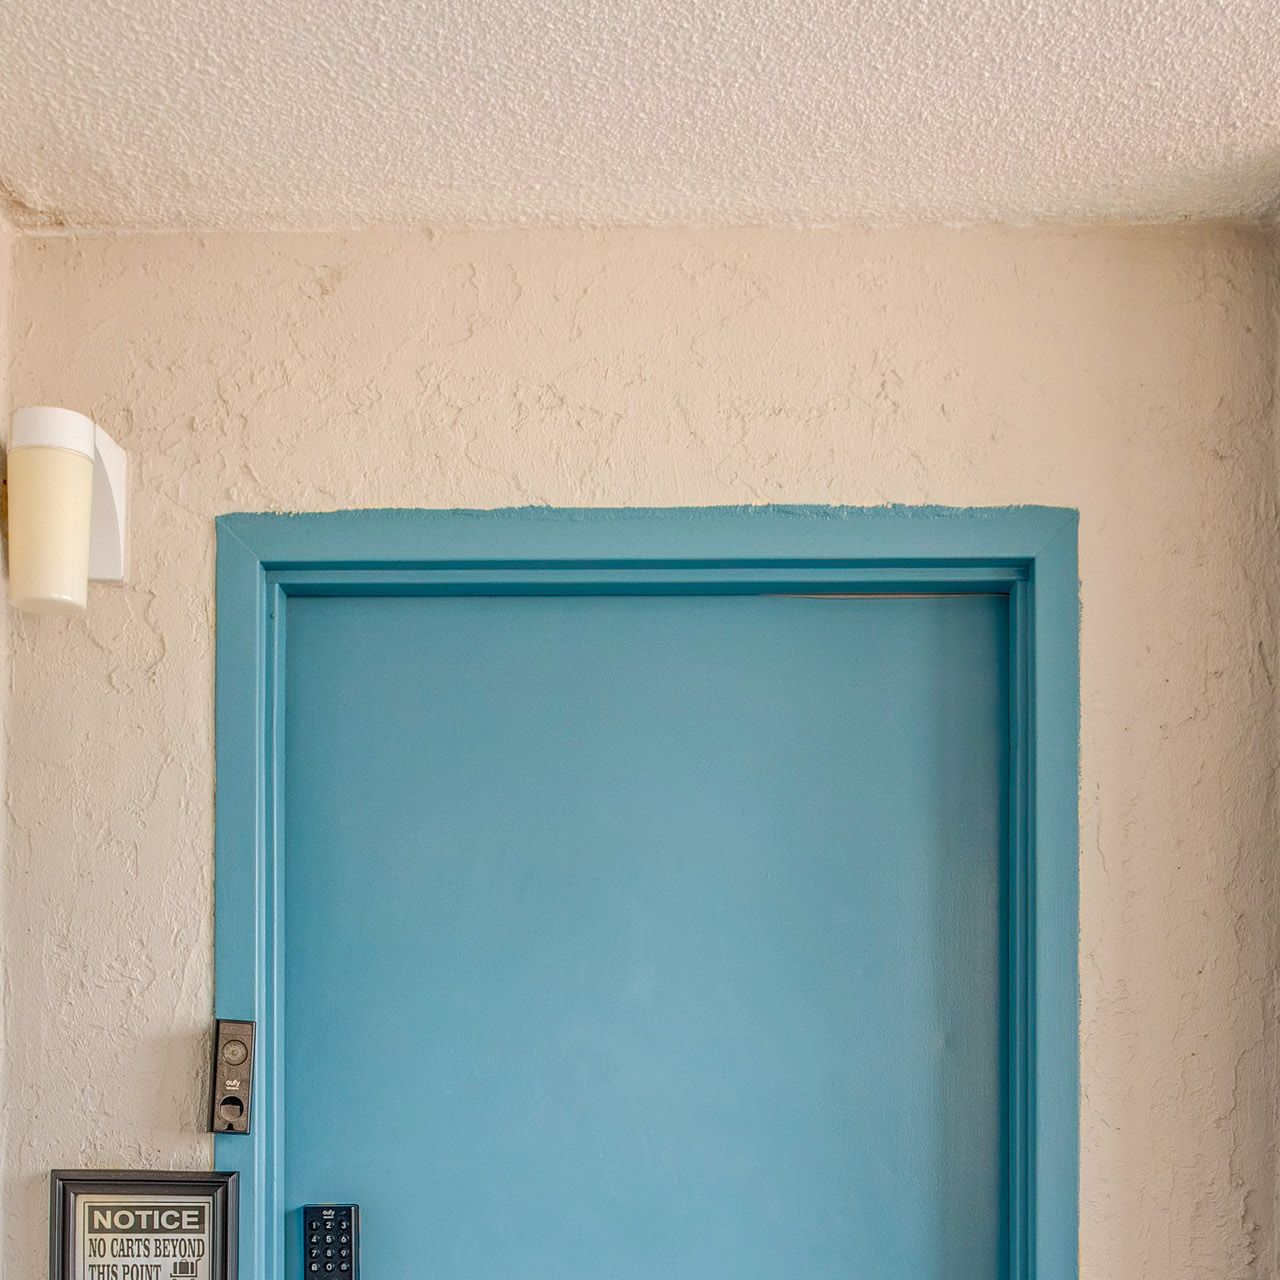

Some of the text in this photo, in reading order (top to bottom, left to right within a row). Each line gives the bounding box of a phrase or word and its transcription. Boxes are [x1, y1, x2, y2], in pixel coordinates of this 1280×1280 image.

[93, 1210, 200, 1230] NOTICE
[88, 1238, 205, 1258] NO CARTS BEYOND
